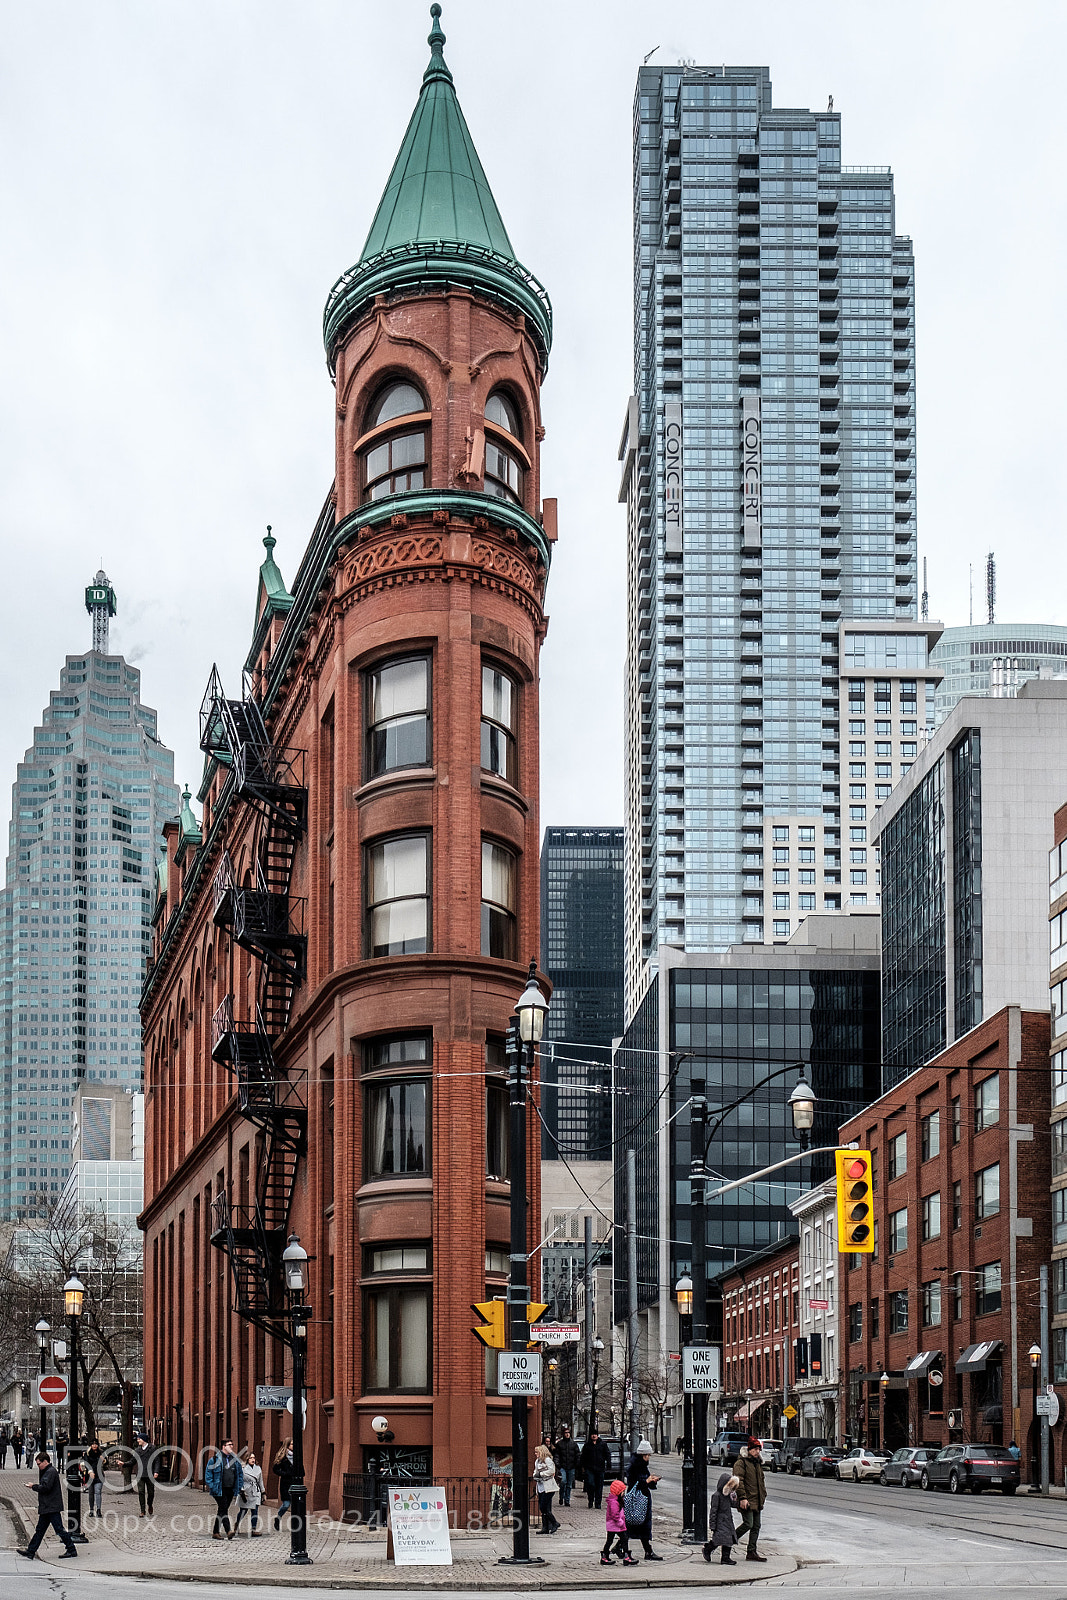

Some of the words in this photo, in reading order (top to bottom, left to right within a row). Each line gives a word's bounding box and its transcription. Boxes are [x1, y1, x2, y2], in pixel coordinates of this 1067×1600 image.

[745, 417, 759, 522] CONCERT
[666, 423, 680, 527] CONCERT
[91, 589, 106, 600] TD
[692, 1351, 710, 1361] ONE
[513, 1357, 528, 1369] NO
[692, 1365, 710, 1375] WAY
[685, 1379, 718, 1389] BEGINS
[394, 1493, 421, 1502] PLAY
[393, 1501, 444, 1510] GROUND
